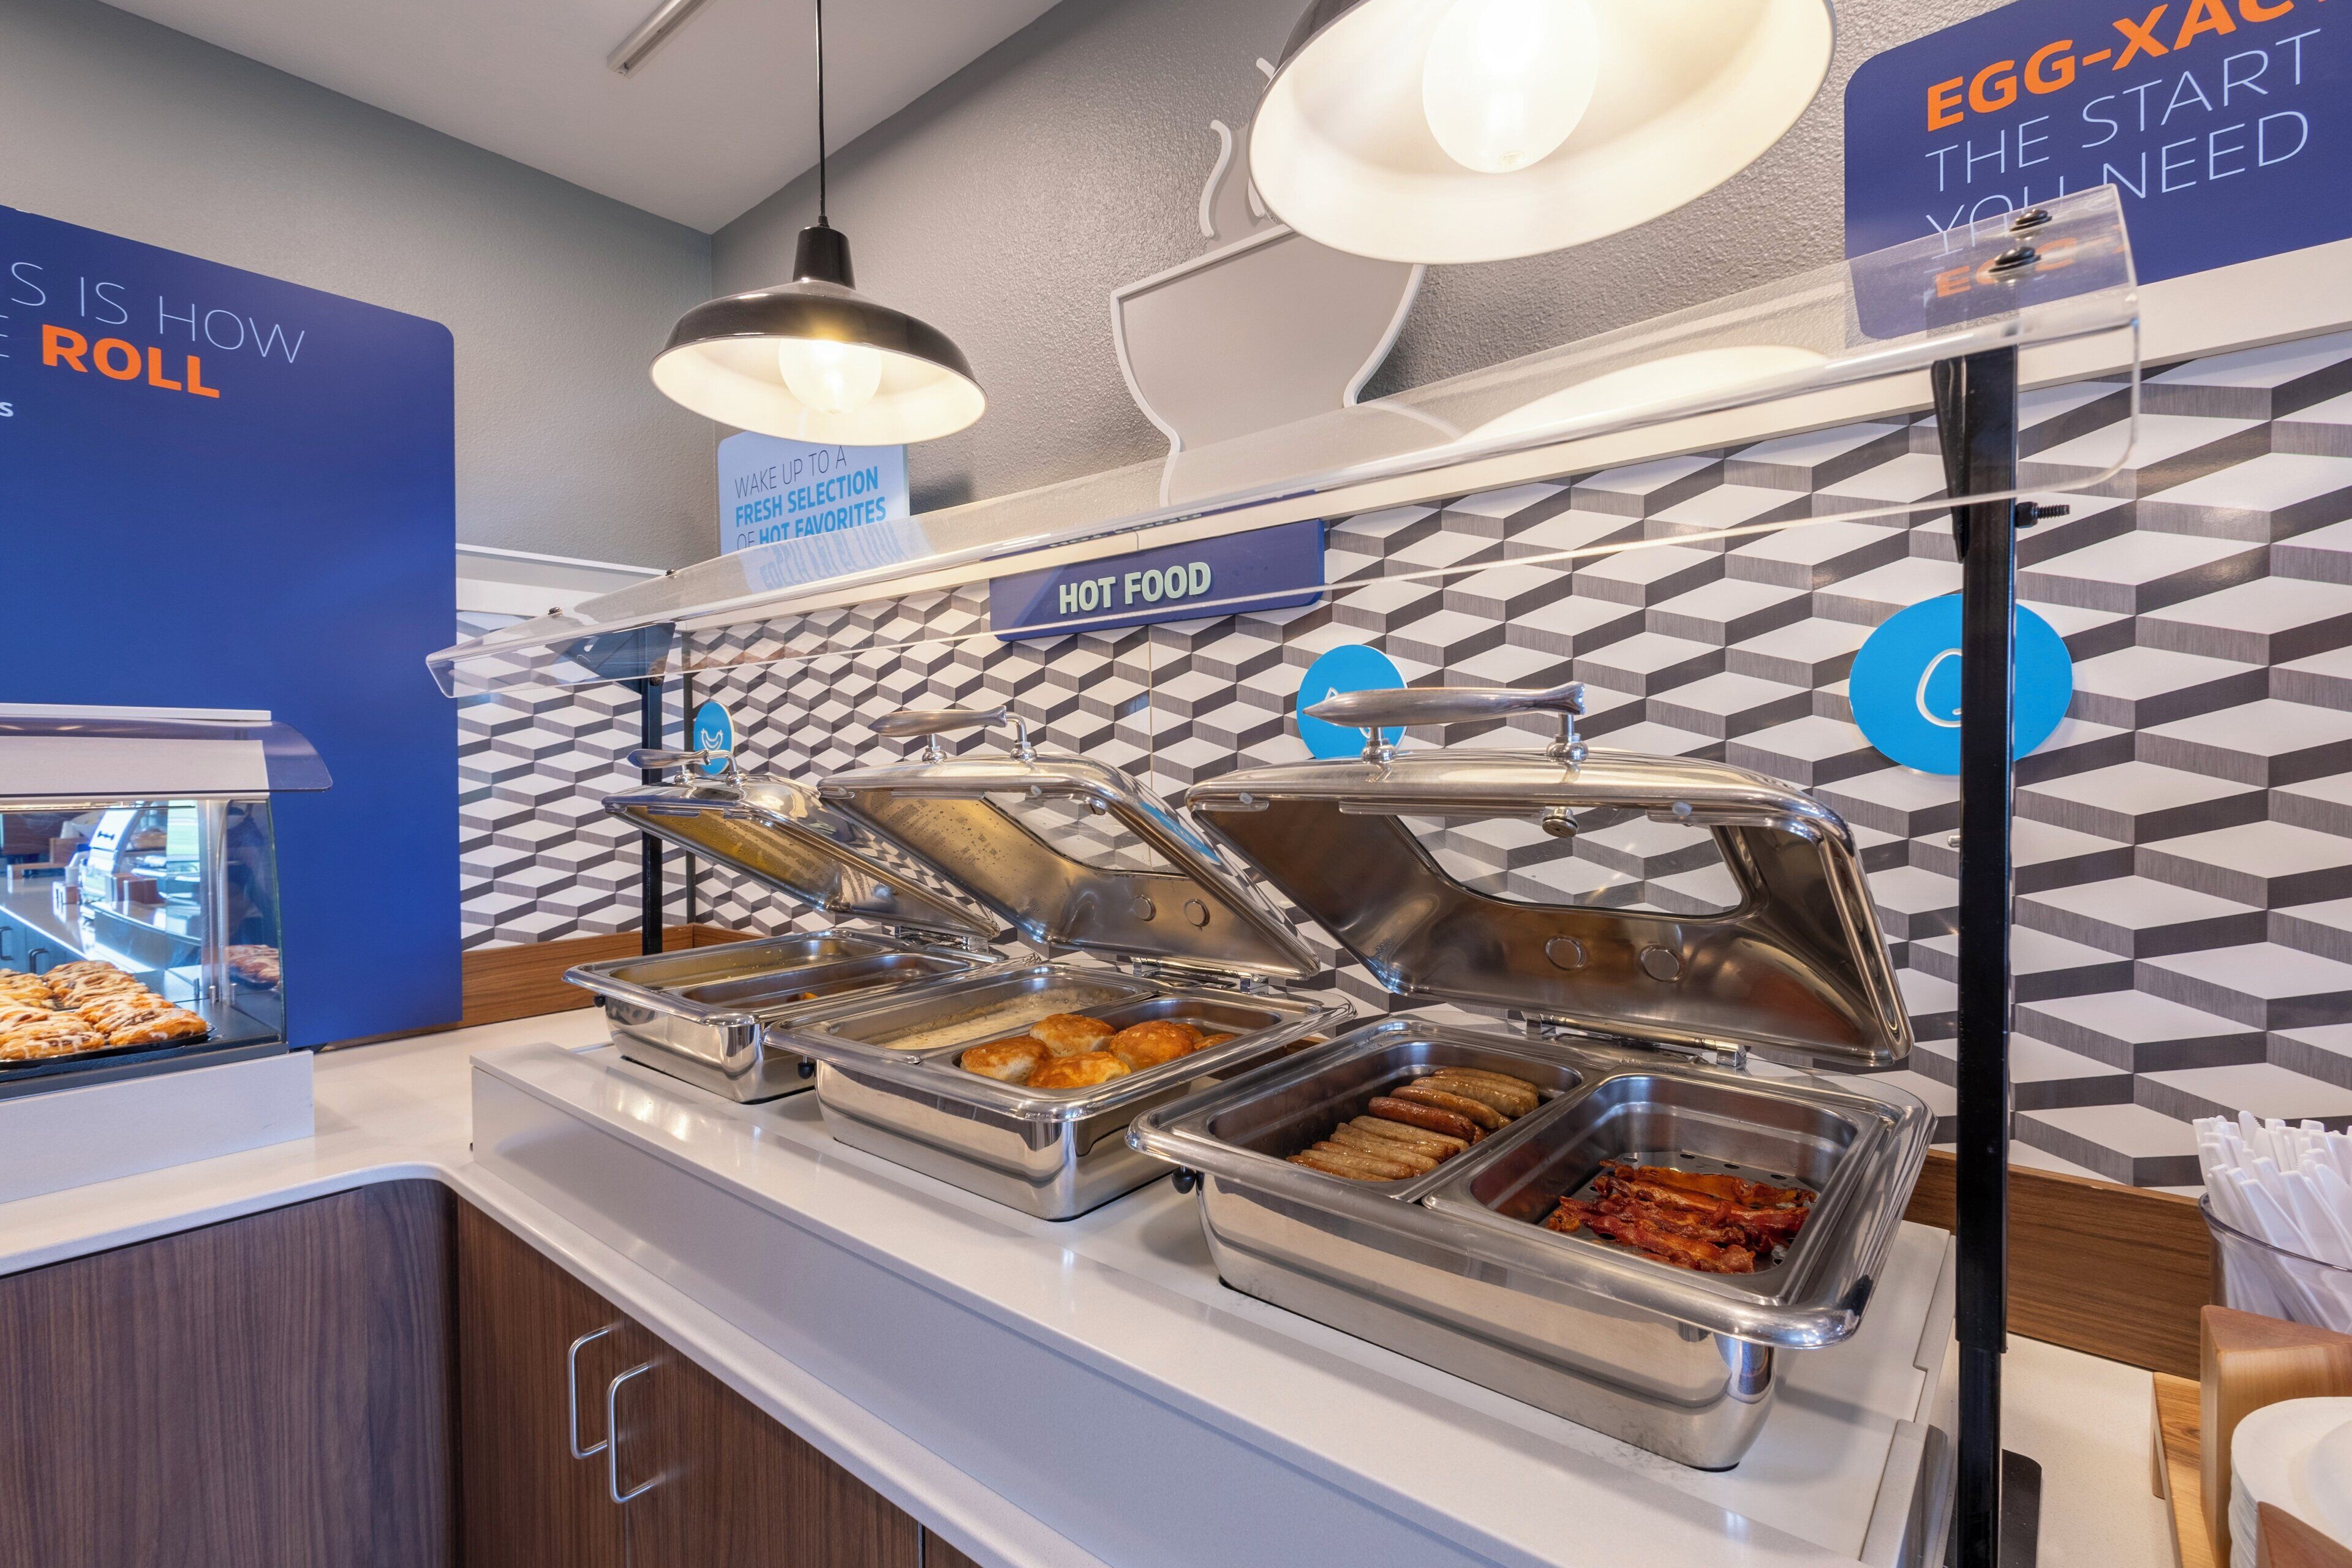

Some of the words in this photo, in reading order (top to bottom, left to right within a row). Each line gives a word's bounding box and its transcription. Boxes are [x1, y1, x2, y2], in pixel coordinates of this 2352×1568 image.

[1928, 0, 2325, 132] EGG-XA
[1926, 116, 2049, 192] THE
[2082, 28, 2321, 149] START
[2103, 111, 2308, 200] NEED
[80, 276, 128, 325] IS
[159, 295, 305, 364] HOW
[42, 324, 220, 399] ROLL
[735, 466, 777, 499] WAKE
[783, 459, 803, 484] UP
[809, 450, 829, 476] TO
[835, 445, 846, 469] A
[735, 494, 783, 527] FRESH
[788, 466, 879, 513] SELECTION
[737, 531, 755, 551] OF
[759, 522, 790, 545] HOT
[796, 497, 887, 537] FAVORITES
[1059, 576, 1116, 614] HOT
[1125, 562, 1212, 605] FOOD
